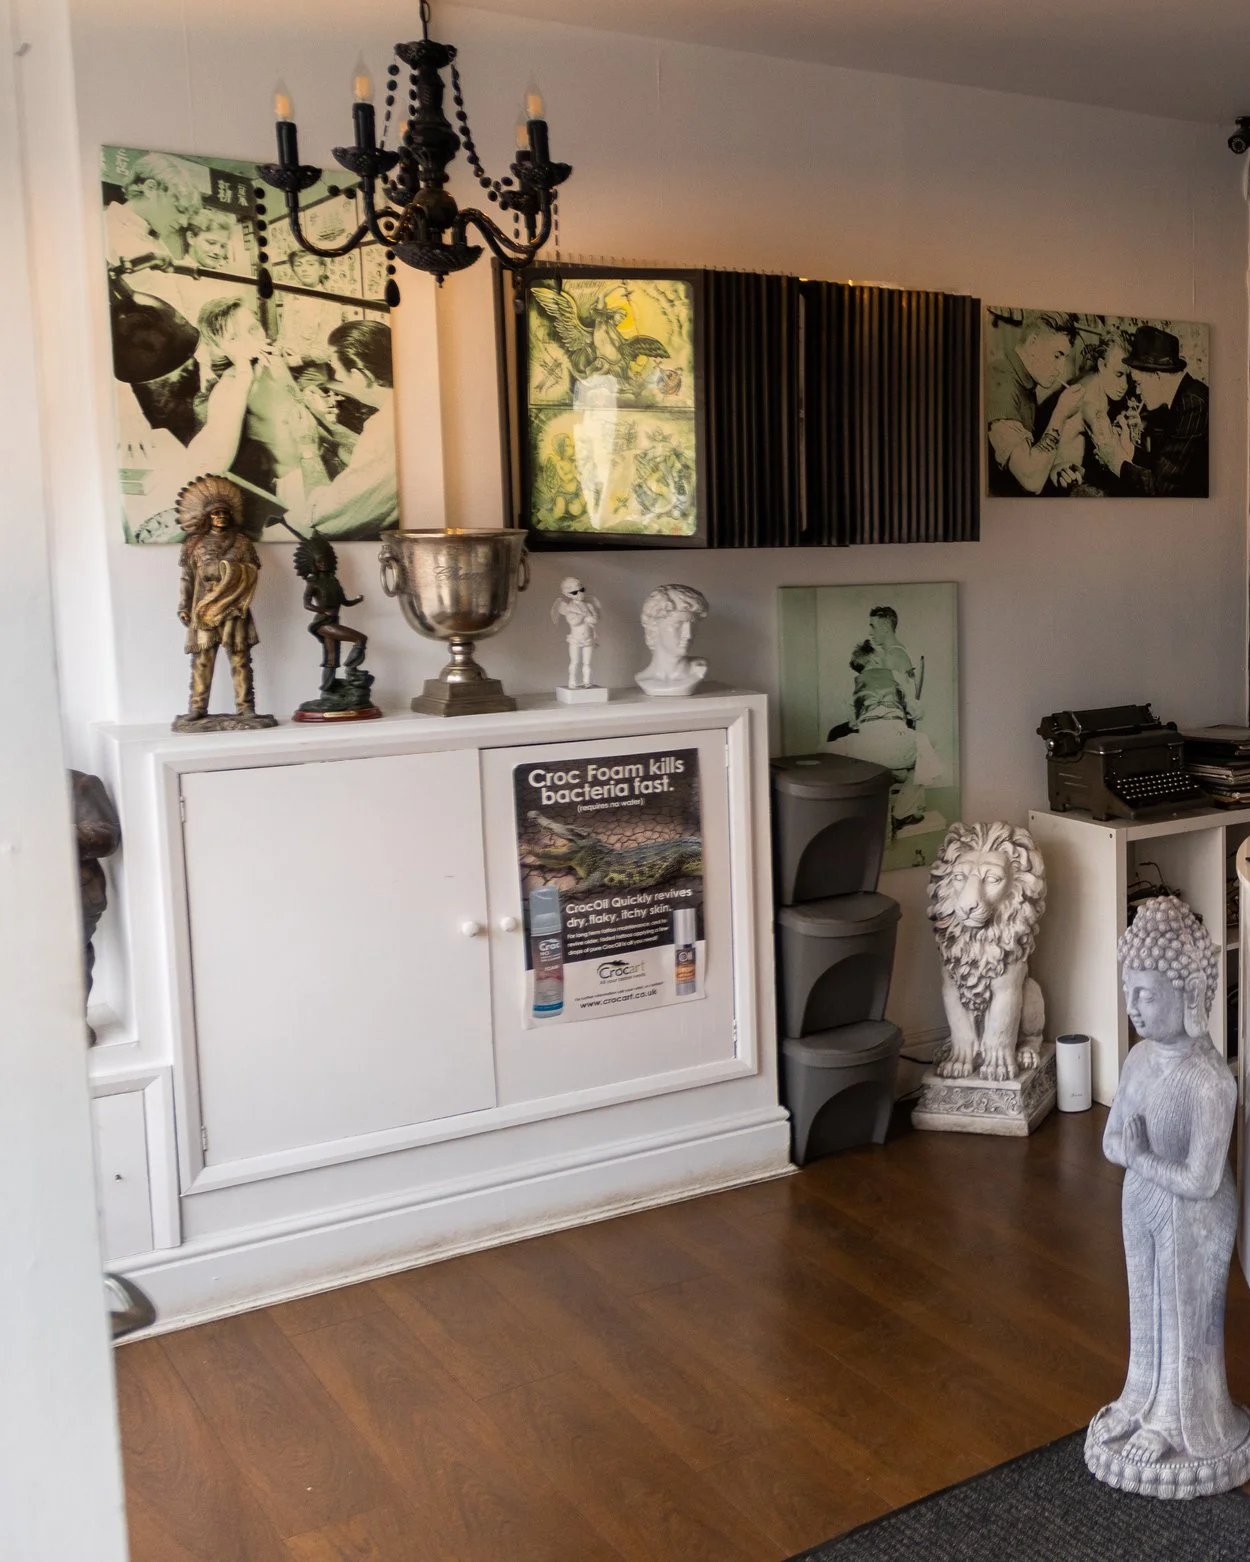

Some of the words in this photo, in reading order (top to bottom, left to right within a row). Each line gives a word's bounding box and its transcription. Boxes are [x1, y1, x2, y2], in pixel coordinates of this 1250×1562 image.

[528, 769, 580, 787] Croc
[587, 764, 644, 782] Foam
[649, 756, 685, 775] kills
[541, 780, 629, 805] bacteria
[634, 775, 675, 795] fast.
[577, 803, 609, 813] (requires
[566, 899, 609, 914] CrocOil
[611, 893, 652, 908] Quickly
[654, 888, 693, 901] revives
[566, 916, 589, 929] dry,
[588, 912, 620, 924] flaky,
[621, 908, 648, 919] itchy
[650, 904, 672, 915] skin.
[598, 962, 646, 980] Crocart
[580, 988, 657, 1008] www.crocart.co.uk
